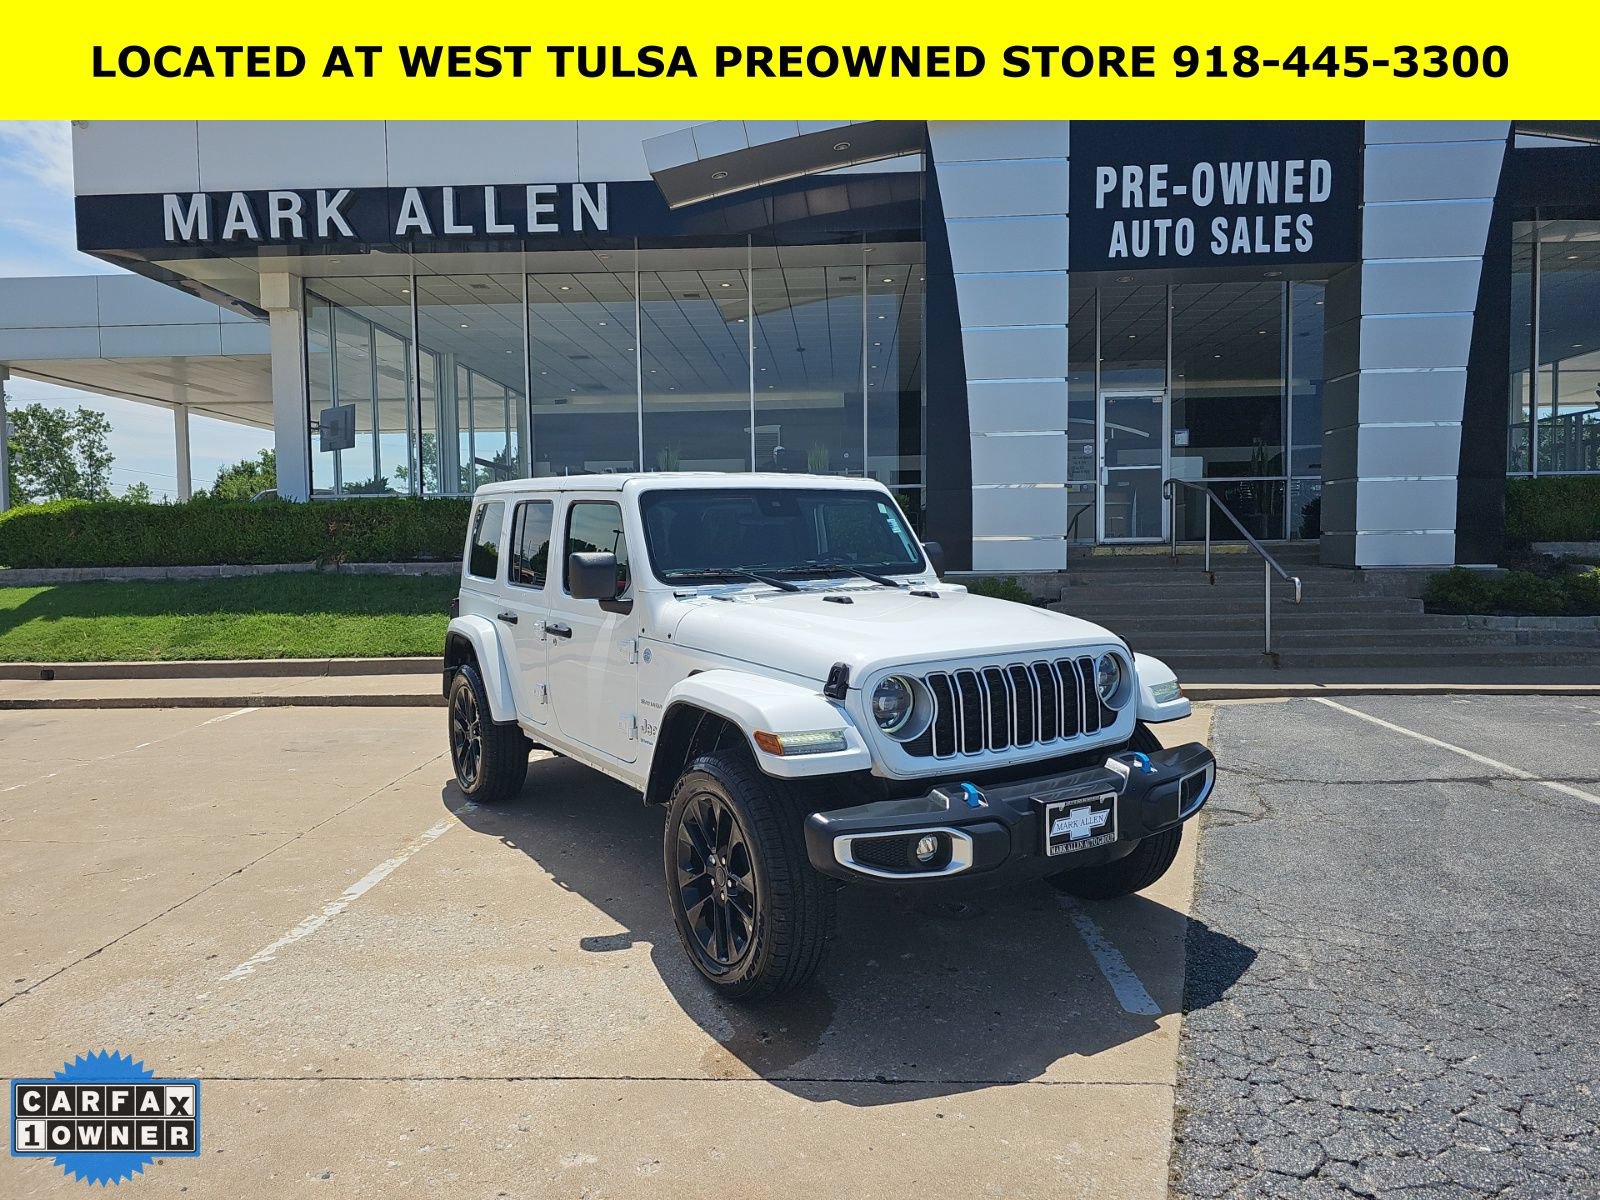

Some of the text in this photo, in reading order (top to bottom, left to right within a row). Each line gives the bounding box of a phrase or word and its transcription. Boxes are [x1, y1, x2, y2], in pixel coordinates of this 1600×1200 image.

[1095, 159, 1332, 209] PRE-OWNED
[163, 183, 608, 241] MARK ALLEN
[1108, 213, 1314, 258] AUTO SALES
[1056, 814, 1104, 831] MARK ALLEN
[1051, 844, 1067, 855] MARK
[1067, 841, 1084, 853] ALLEN
